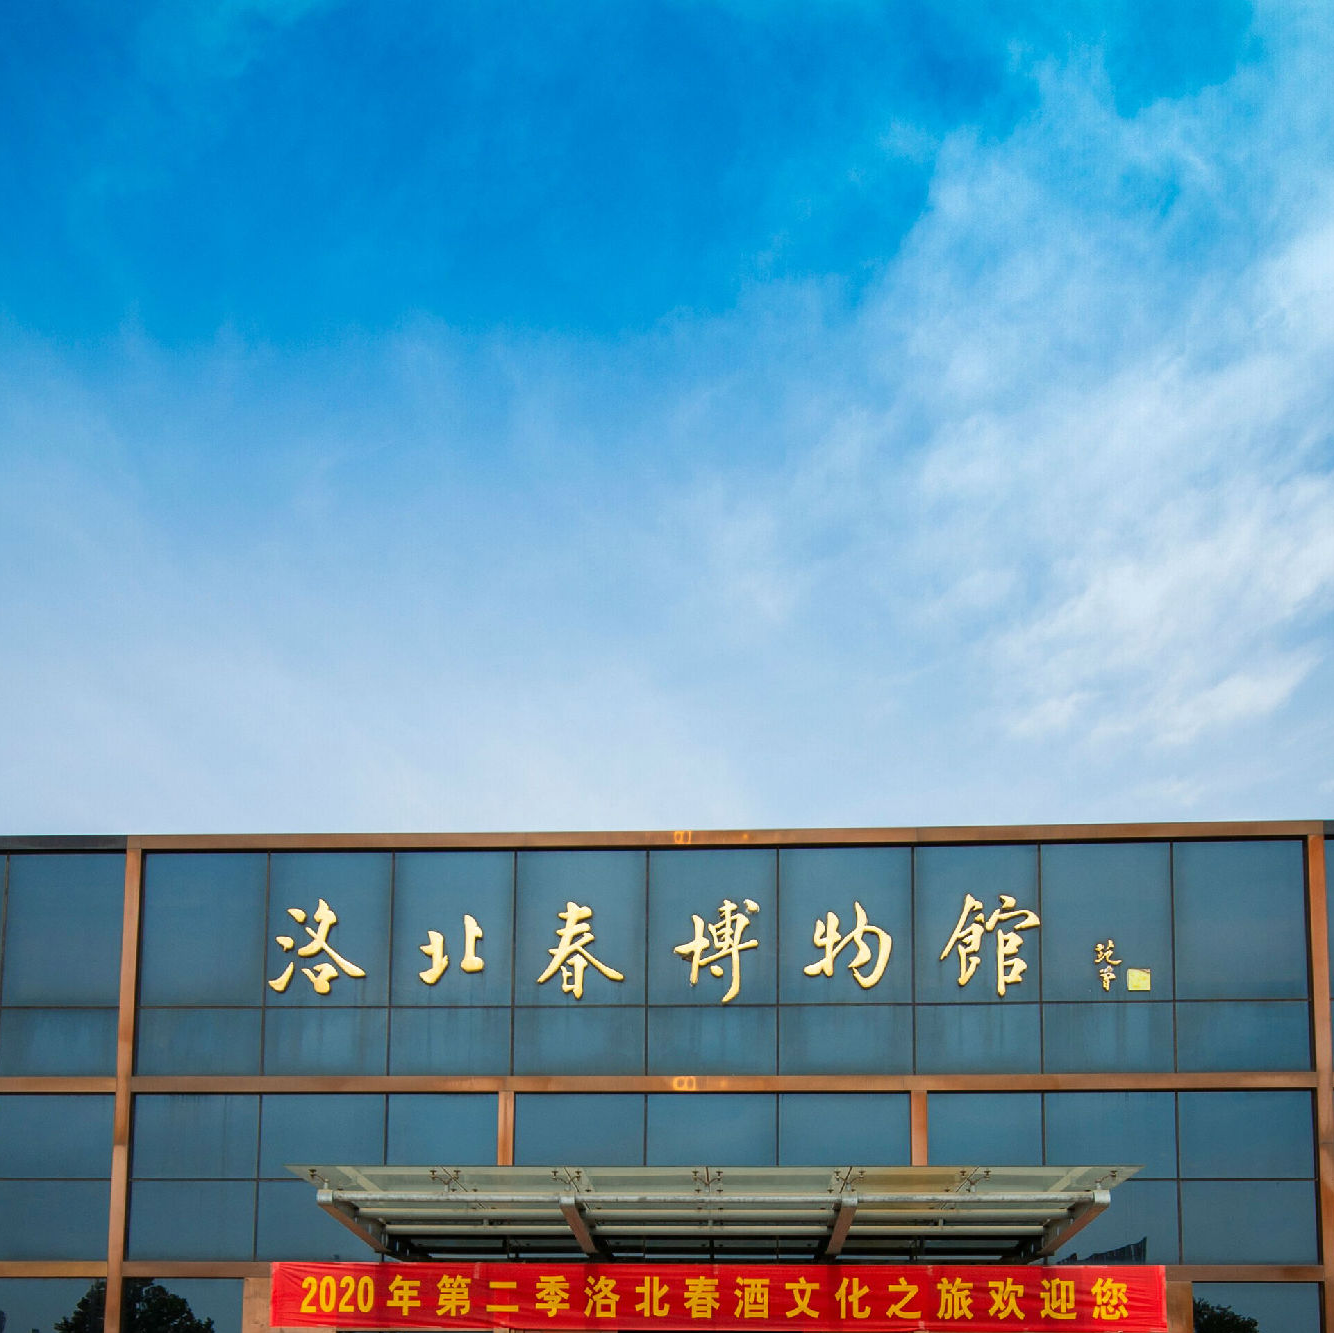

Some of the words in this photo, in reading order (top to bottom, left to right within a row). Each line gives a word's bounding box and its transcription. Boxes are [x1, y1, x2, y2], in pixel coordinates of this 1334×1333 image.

[268, 893, 1041, 1003] 洛北春博物館
[299, 1273, 1129, 1321] 2020年第二季洛北春酒文化之旅欢迎您
